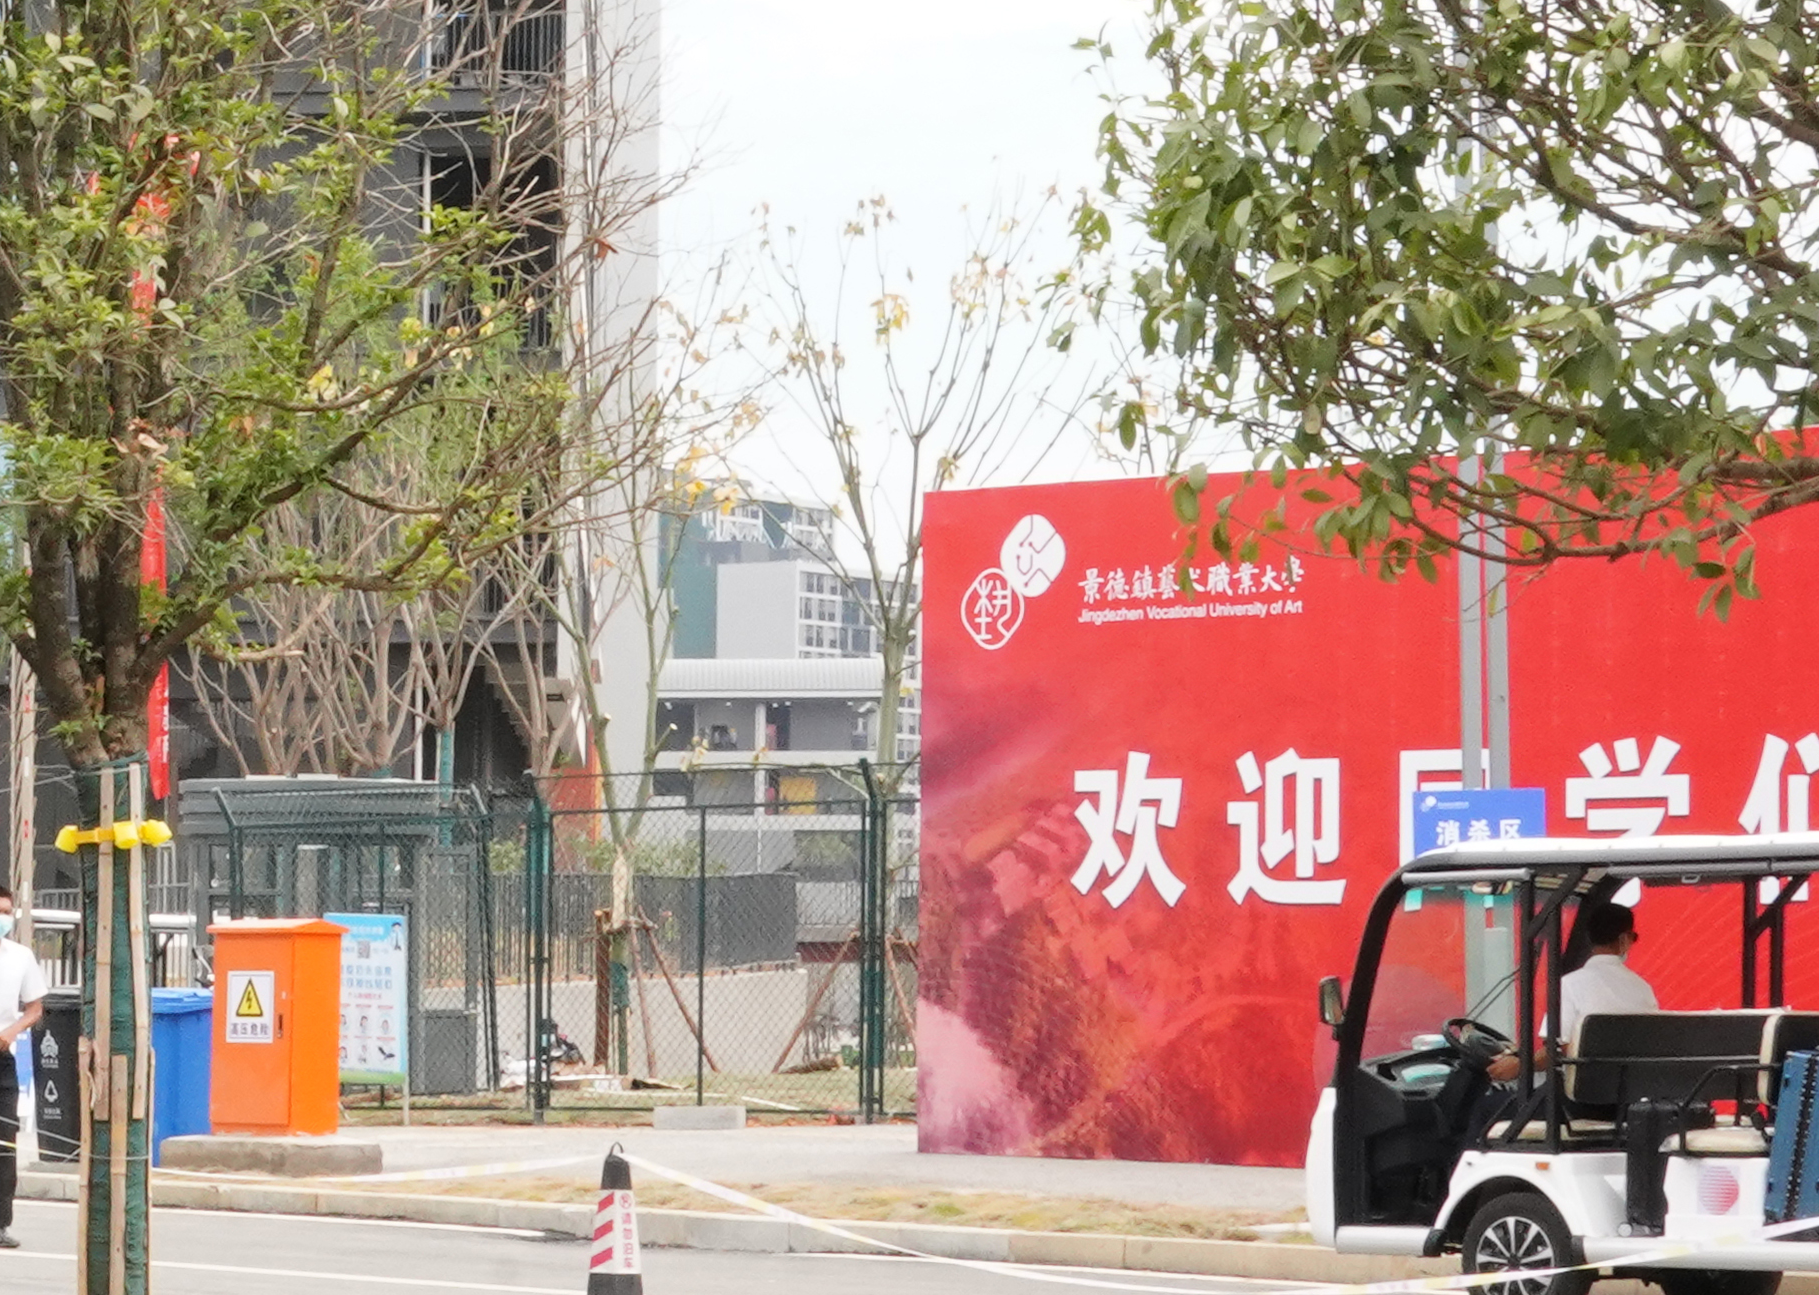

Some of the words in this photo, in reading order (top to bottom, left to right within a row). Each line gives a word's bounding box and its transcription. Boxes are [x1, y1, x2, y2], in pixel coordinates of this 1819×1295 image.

[1078, 607, 1145, 626] Jingdezhen
[1146, 603, 1208, 620] Vocational
[1208, 601, 1269, 619] University
[1269, 599, 1283, 615] of
[1283, 599, 1304, 614] Art
